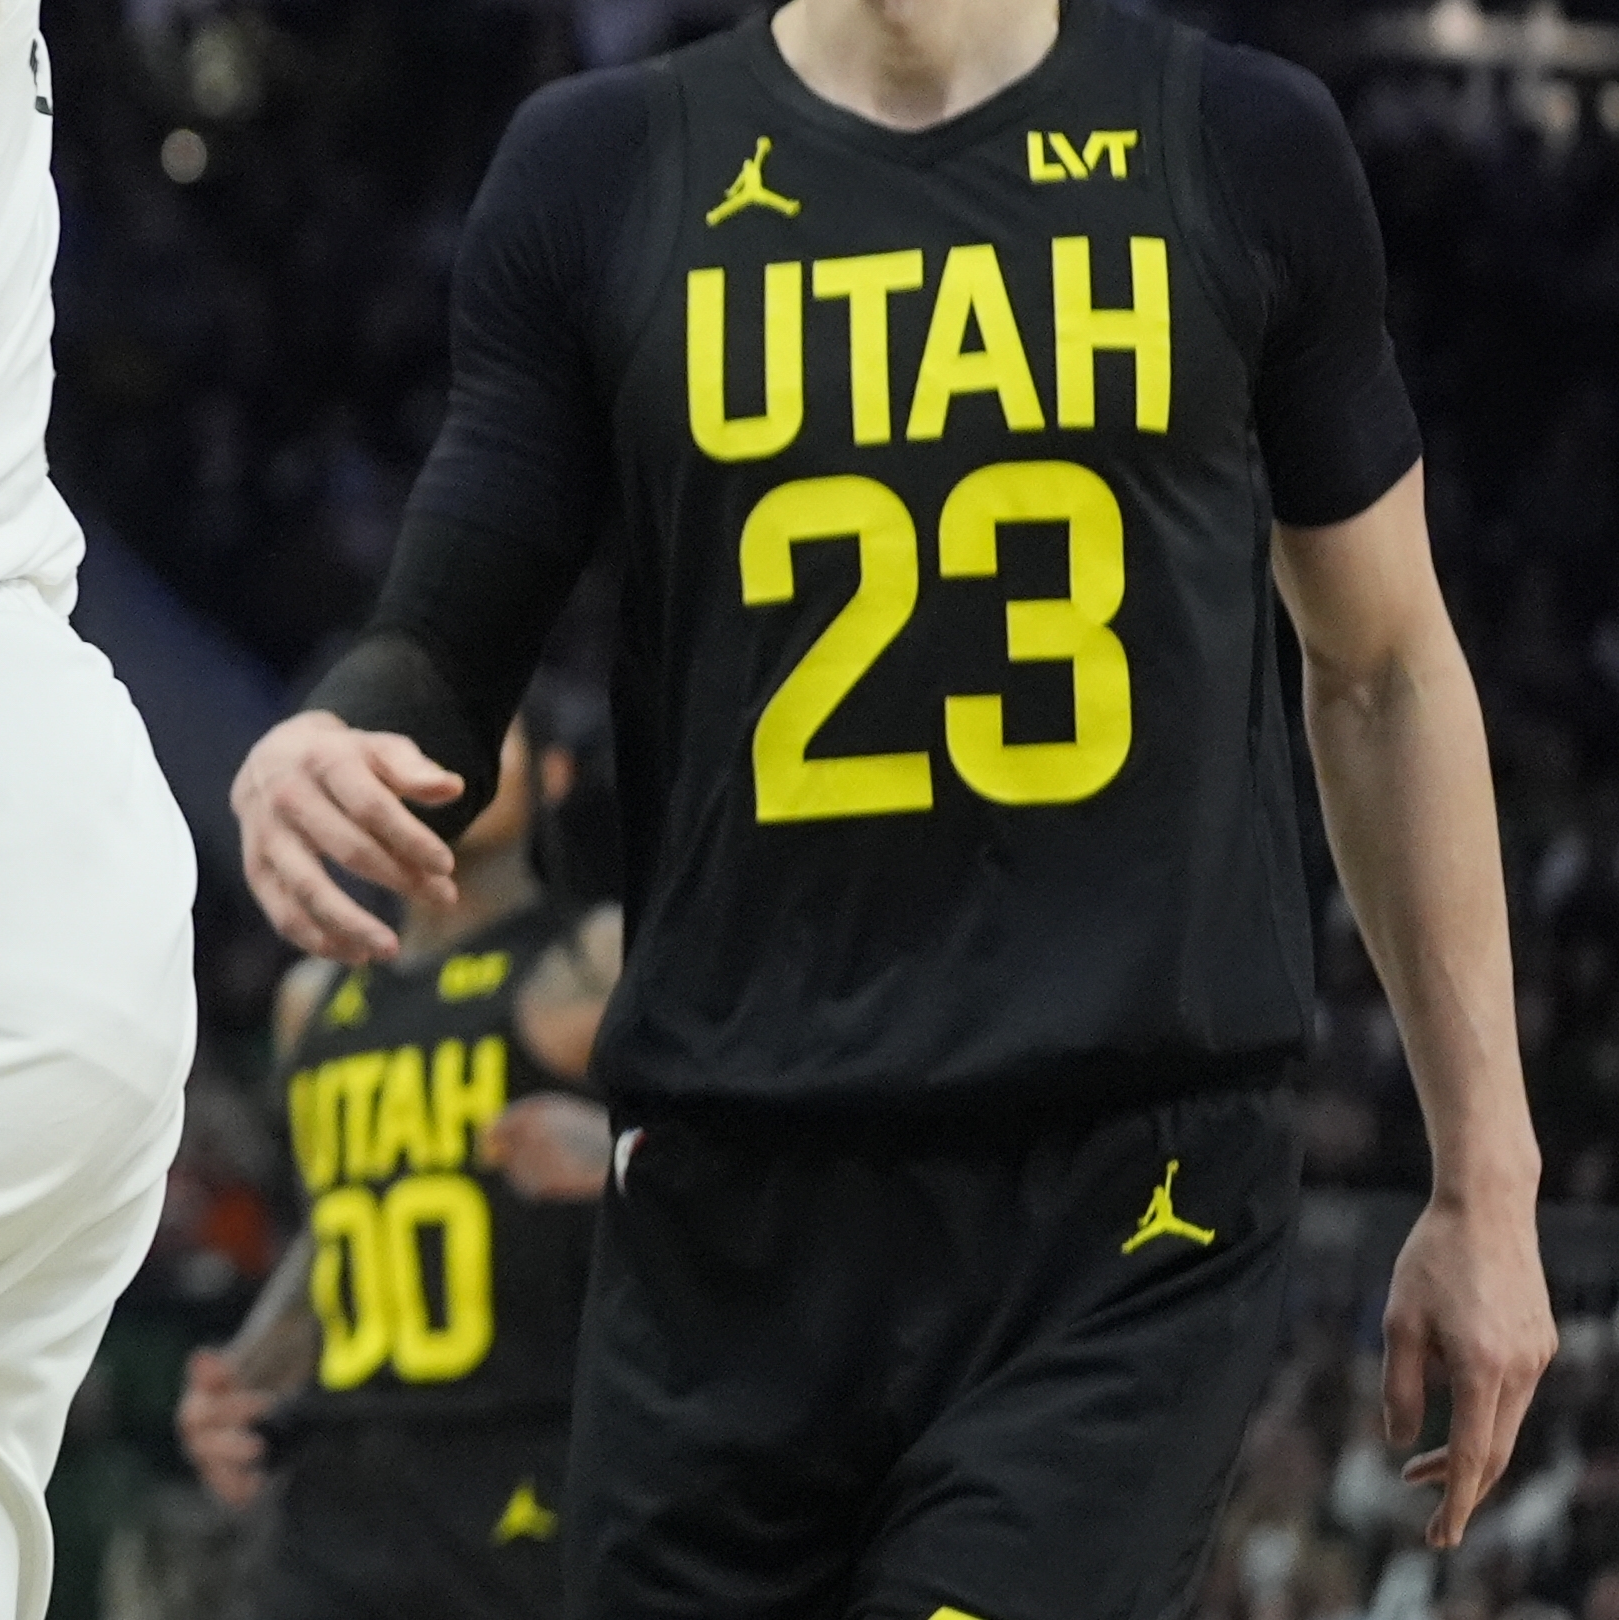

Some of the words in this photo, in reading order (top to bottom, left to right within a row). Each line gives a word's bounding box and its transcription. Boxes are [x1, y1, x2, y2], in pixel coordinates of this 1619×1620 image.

[1027, 129, 1139, 183] LVT
[686, 235, 1172, 463] UTAH
[739, 459, 1133, 824] 23
[288, 1034, 509, 1196] UTAH
[310, 1172, 496, 1392] 00
